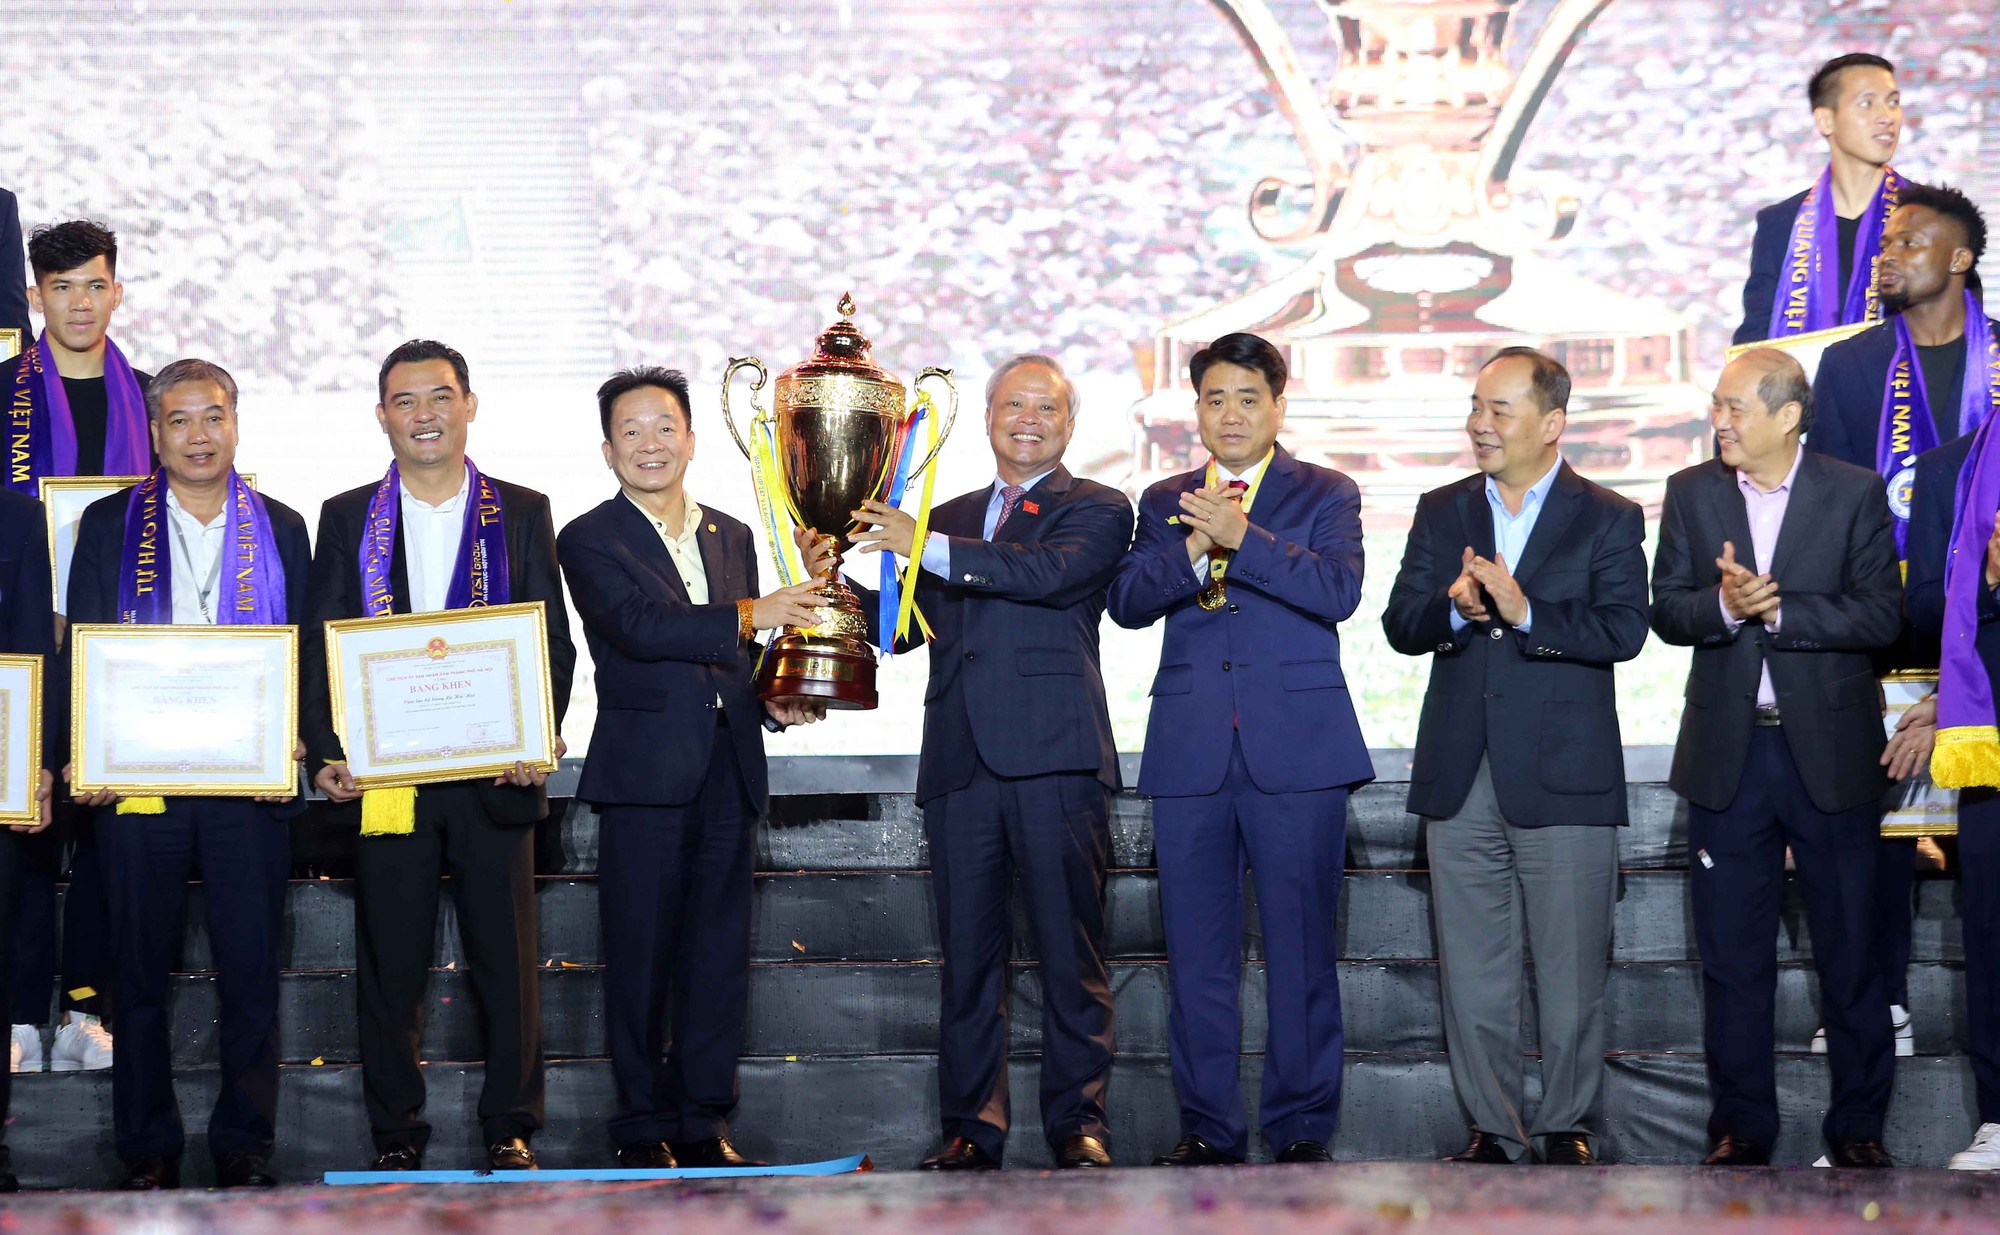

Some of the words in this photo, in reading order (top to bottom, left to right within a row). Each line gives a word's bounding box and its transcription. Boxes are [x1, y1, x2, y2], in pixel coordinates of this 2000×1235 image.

[1791, 211, 1815, 283] QUANG
[8, 388, 33, 430] VIỆT
[1892, 404, 1911, 454] NAM
[11, 433, 31, 483] NAM
[135, 568, 158, 597] TỰ
[236, 567, 254, 612] NAM
[368, 575, 394, 616] VIỆT
[470, 567, 483, 599] T&T
[186, 695, 217, 705] KHEN
[442, 680, 472, 690] KHEN
